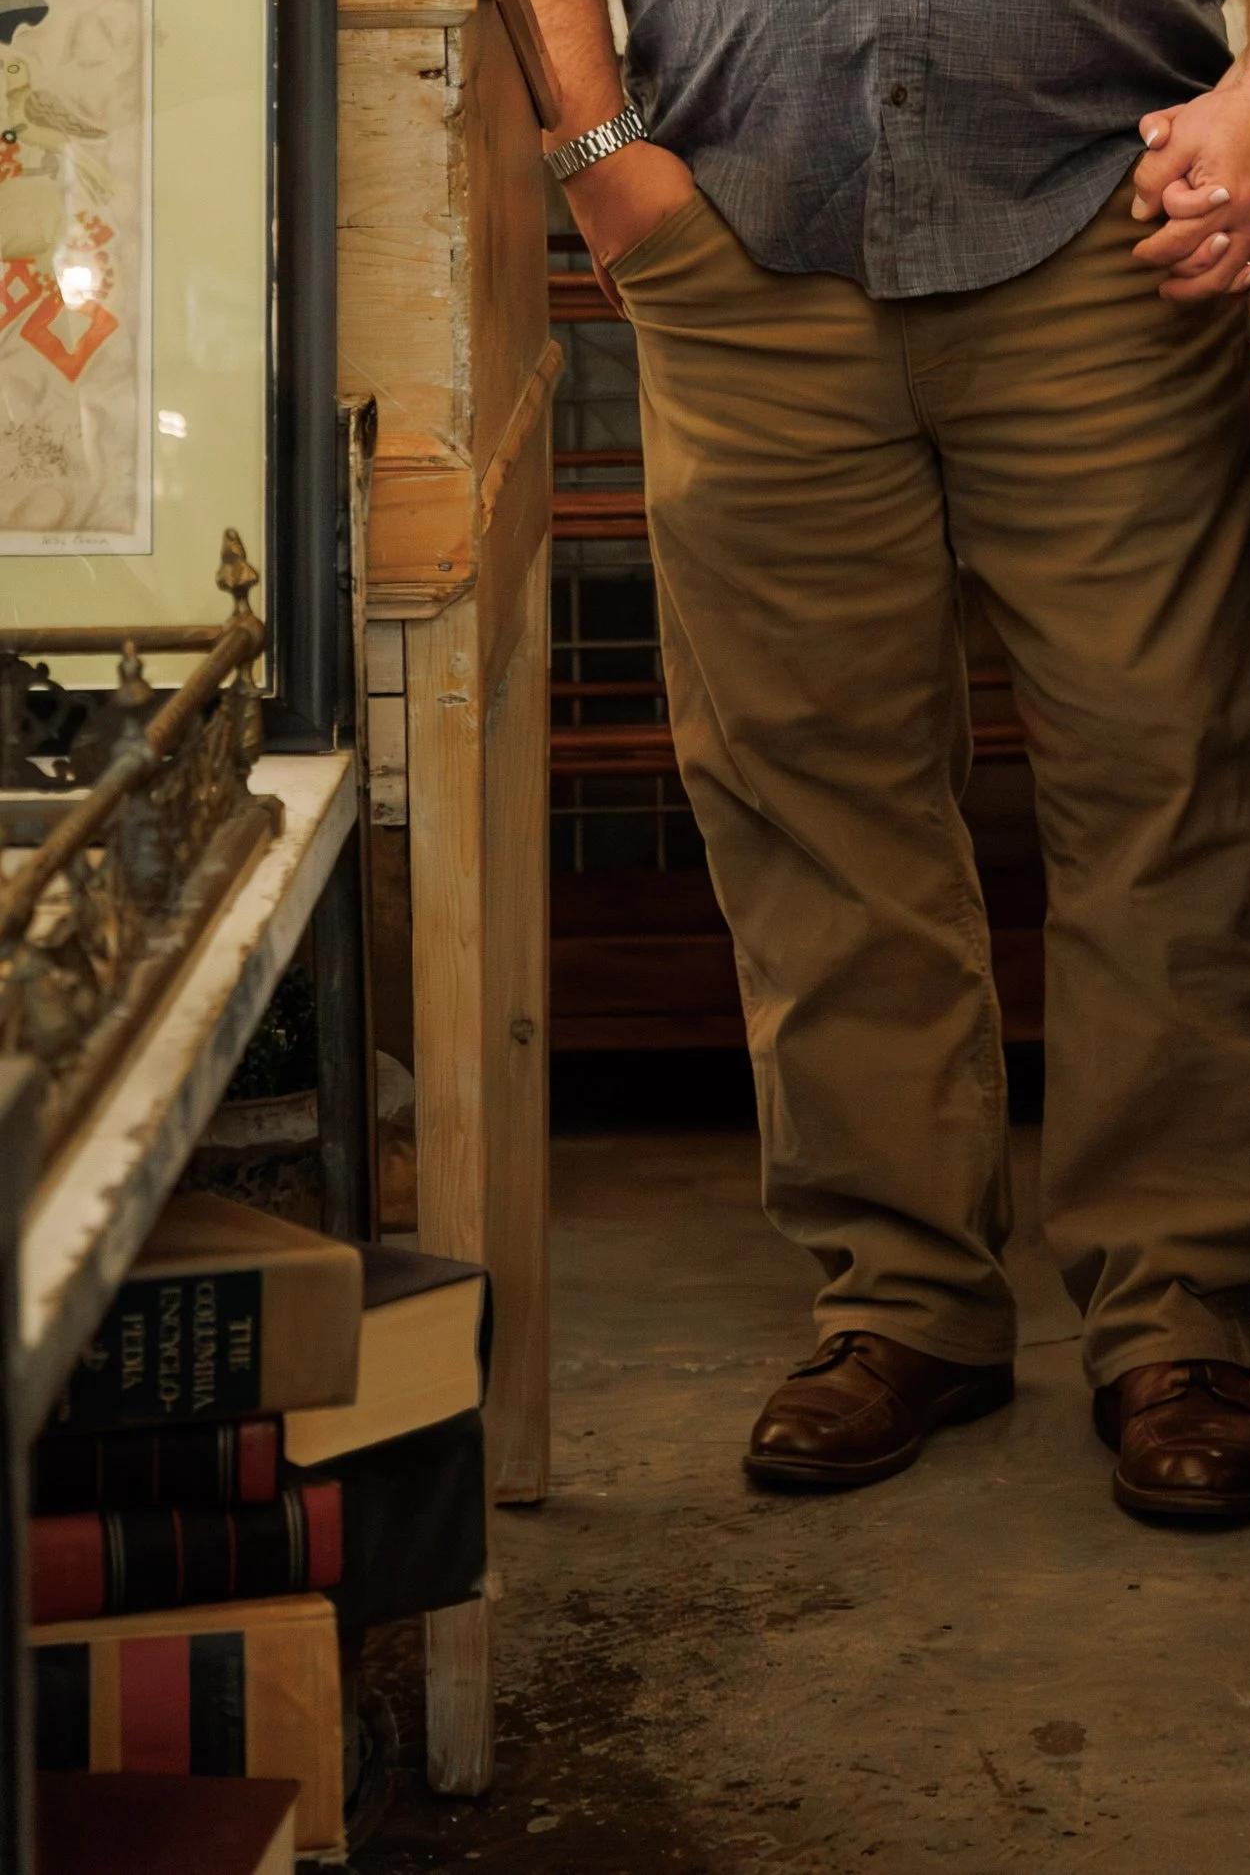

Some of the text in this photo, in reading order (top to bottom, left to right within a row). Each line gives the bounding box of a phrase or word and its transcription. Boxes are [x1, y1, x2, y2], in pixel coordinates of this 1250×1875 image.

[121, 1313, 145, 1390] PEDIA
[159, 1287, 182, 1413] ENCYCLO-
[193, 1280, 217, 1410] COLUMBIA
[228, 1315, 253, 1372] THE
